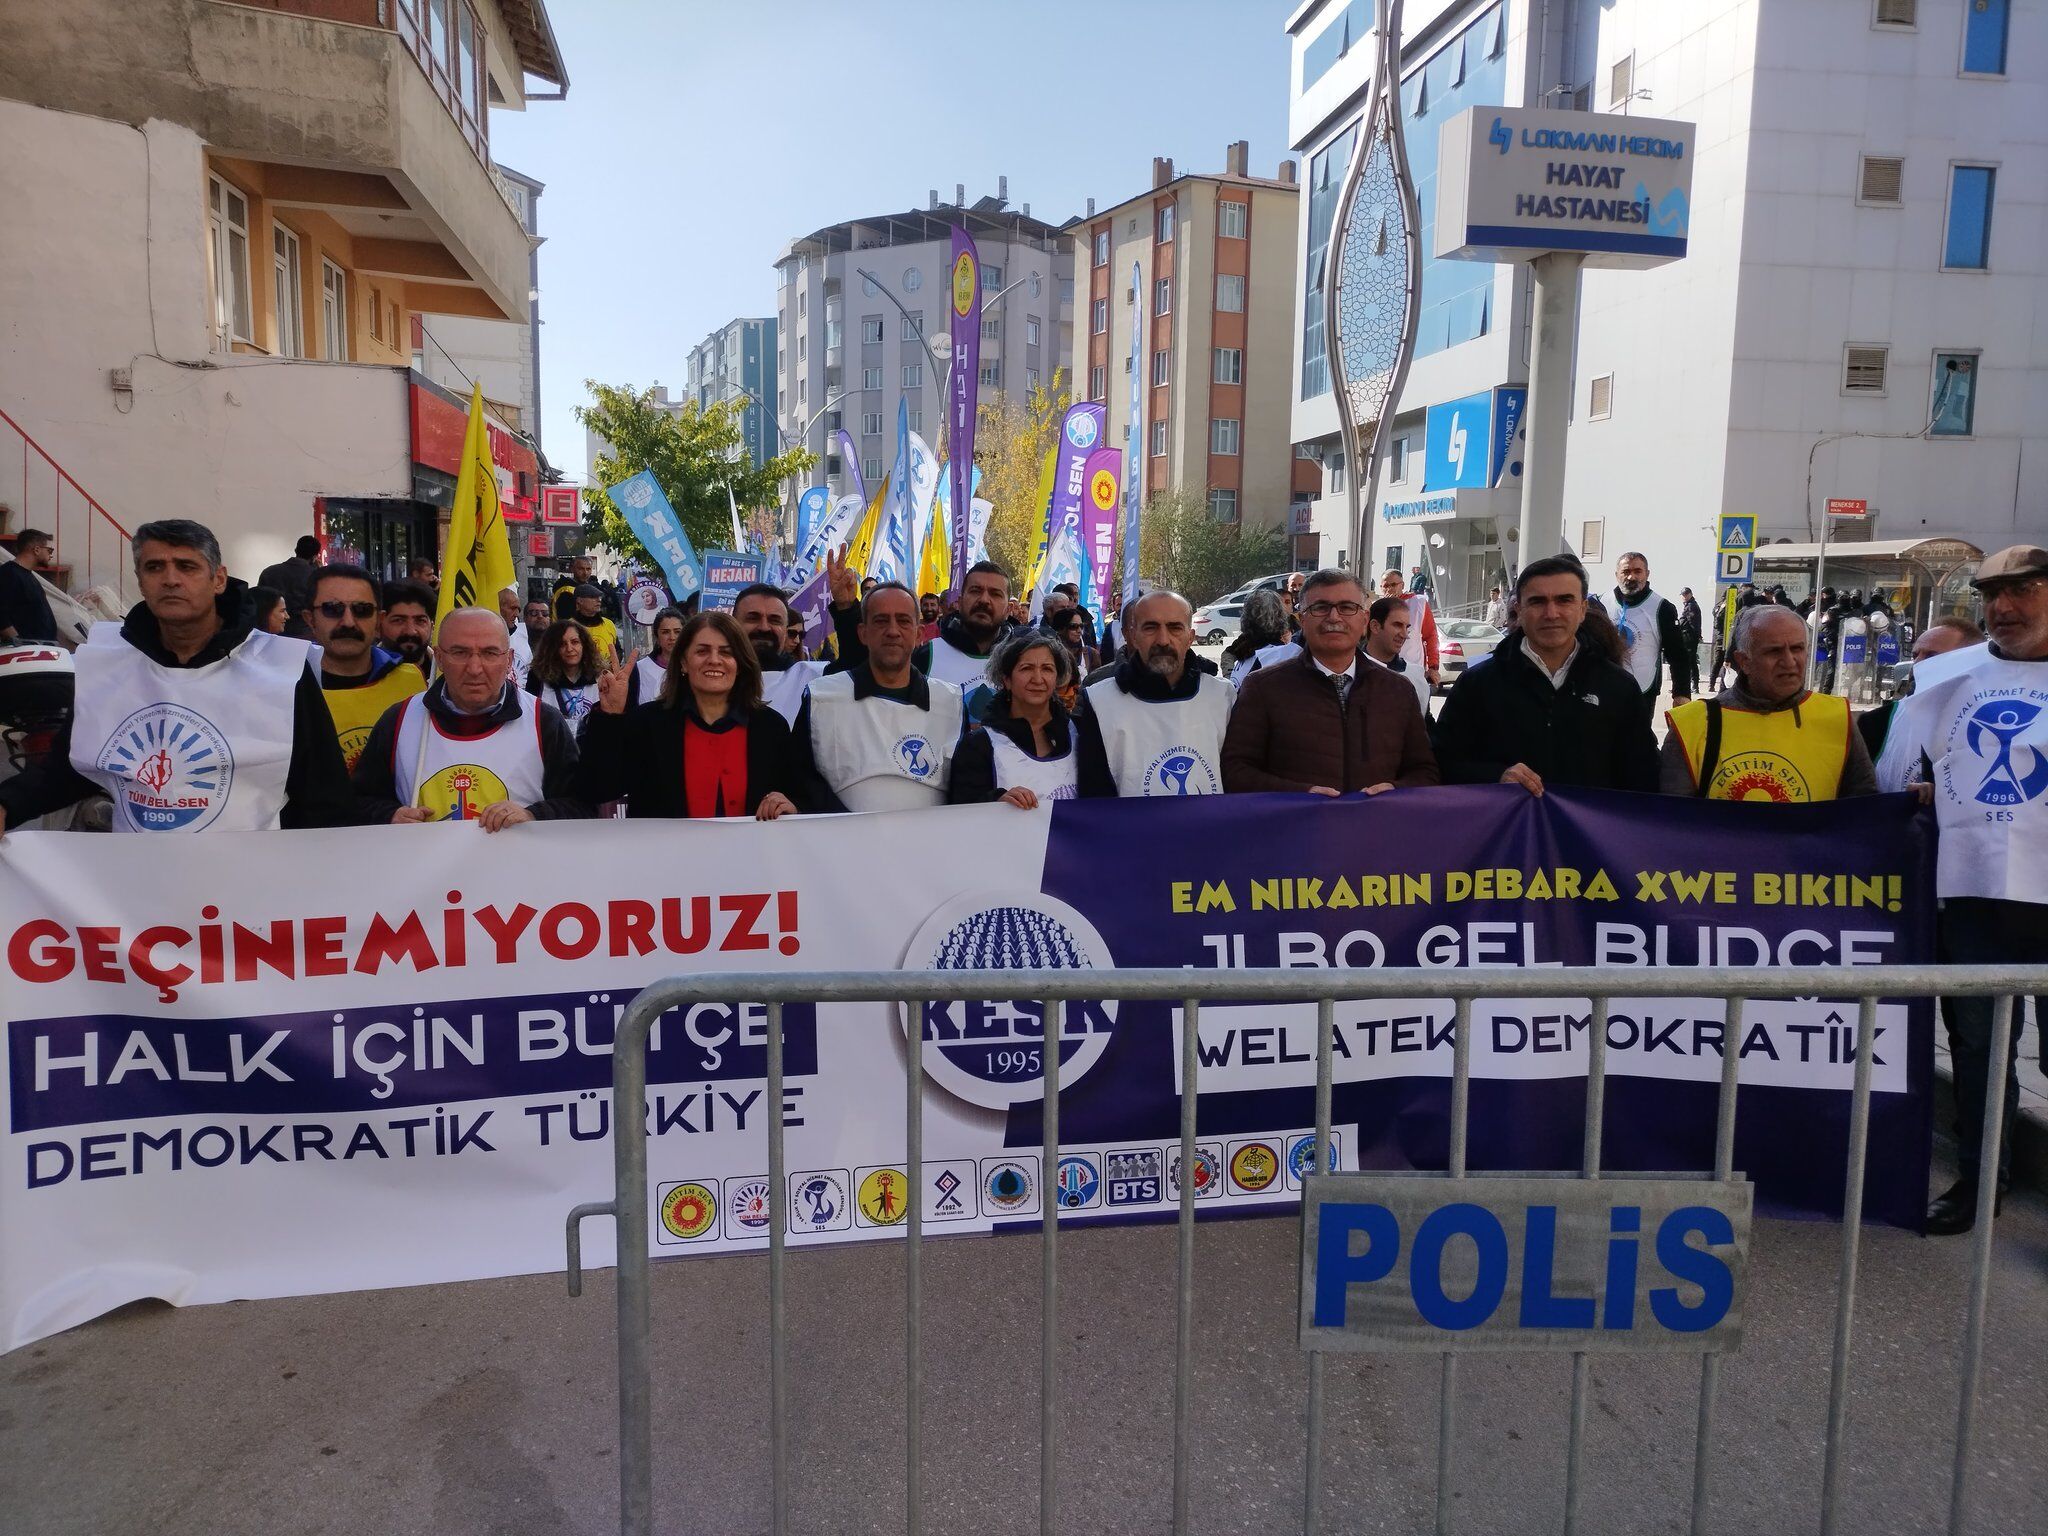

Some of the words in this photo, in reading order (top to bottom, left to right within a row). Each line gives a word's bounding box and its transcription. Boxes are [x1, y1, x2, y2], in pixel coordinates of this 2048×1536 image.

[1522, 128, 1616, 154] LOKMAN
[1546, 163, 1625, 189] HAYAT
[1516, 194, 1650, 224] HASTANESİ
[1068, 456, 1087, 497] SEN
[711, 565, 757, 583] HEJARÎ
[1726, 555, 1743, 575] D
[1974, 687, 2026, 701] HİZMET
[118, 721, 134, 738] Yerel
[1144, 760, 1160, 786] SOSYAL
[1160, 746, 1187, 760] HİZMET
[1718, 758, 1774, 788] EĞİTİM
[1778, 768, 1804, 797] SEN
[455, 778, 471, 788] BES
[128, 790, 146, 805] TÜM
[147, 797, 209, 808] BEL-SEN
[1985, 793, 2015, 803] 1996
[142, 811, 176, 823] 1990
[1986, 812, 2014, 822] SES
[1171, 879, 1237, 914] EM
[1251, 872, 1431, 911] NIKARIN
[1446, 866, 1620, 903] DEBARA
[1635, 870, 1737, 905] XWE
[1754, 872, 1903, 912] BIKIN!
[7, 890, 800, 1004] GEÇİNEMİYORUZ!
[1279, 930, 1386, 969] BO
[921, 1000, 1115, 1041] KESK
[35, 1030, 295, 1091] HALK
[332, 1007, 485, 1099] İÇİN
[985, 1050, 1040, 1075] 1995
[27, 1106, 497, 1190] DEMOKRATİK
[697, 1190, 713, 1205] SEN
[1113, 1181, 1156, 1200] BTS
